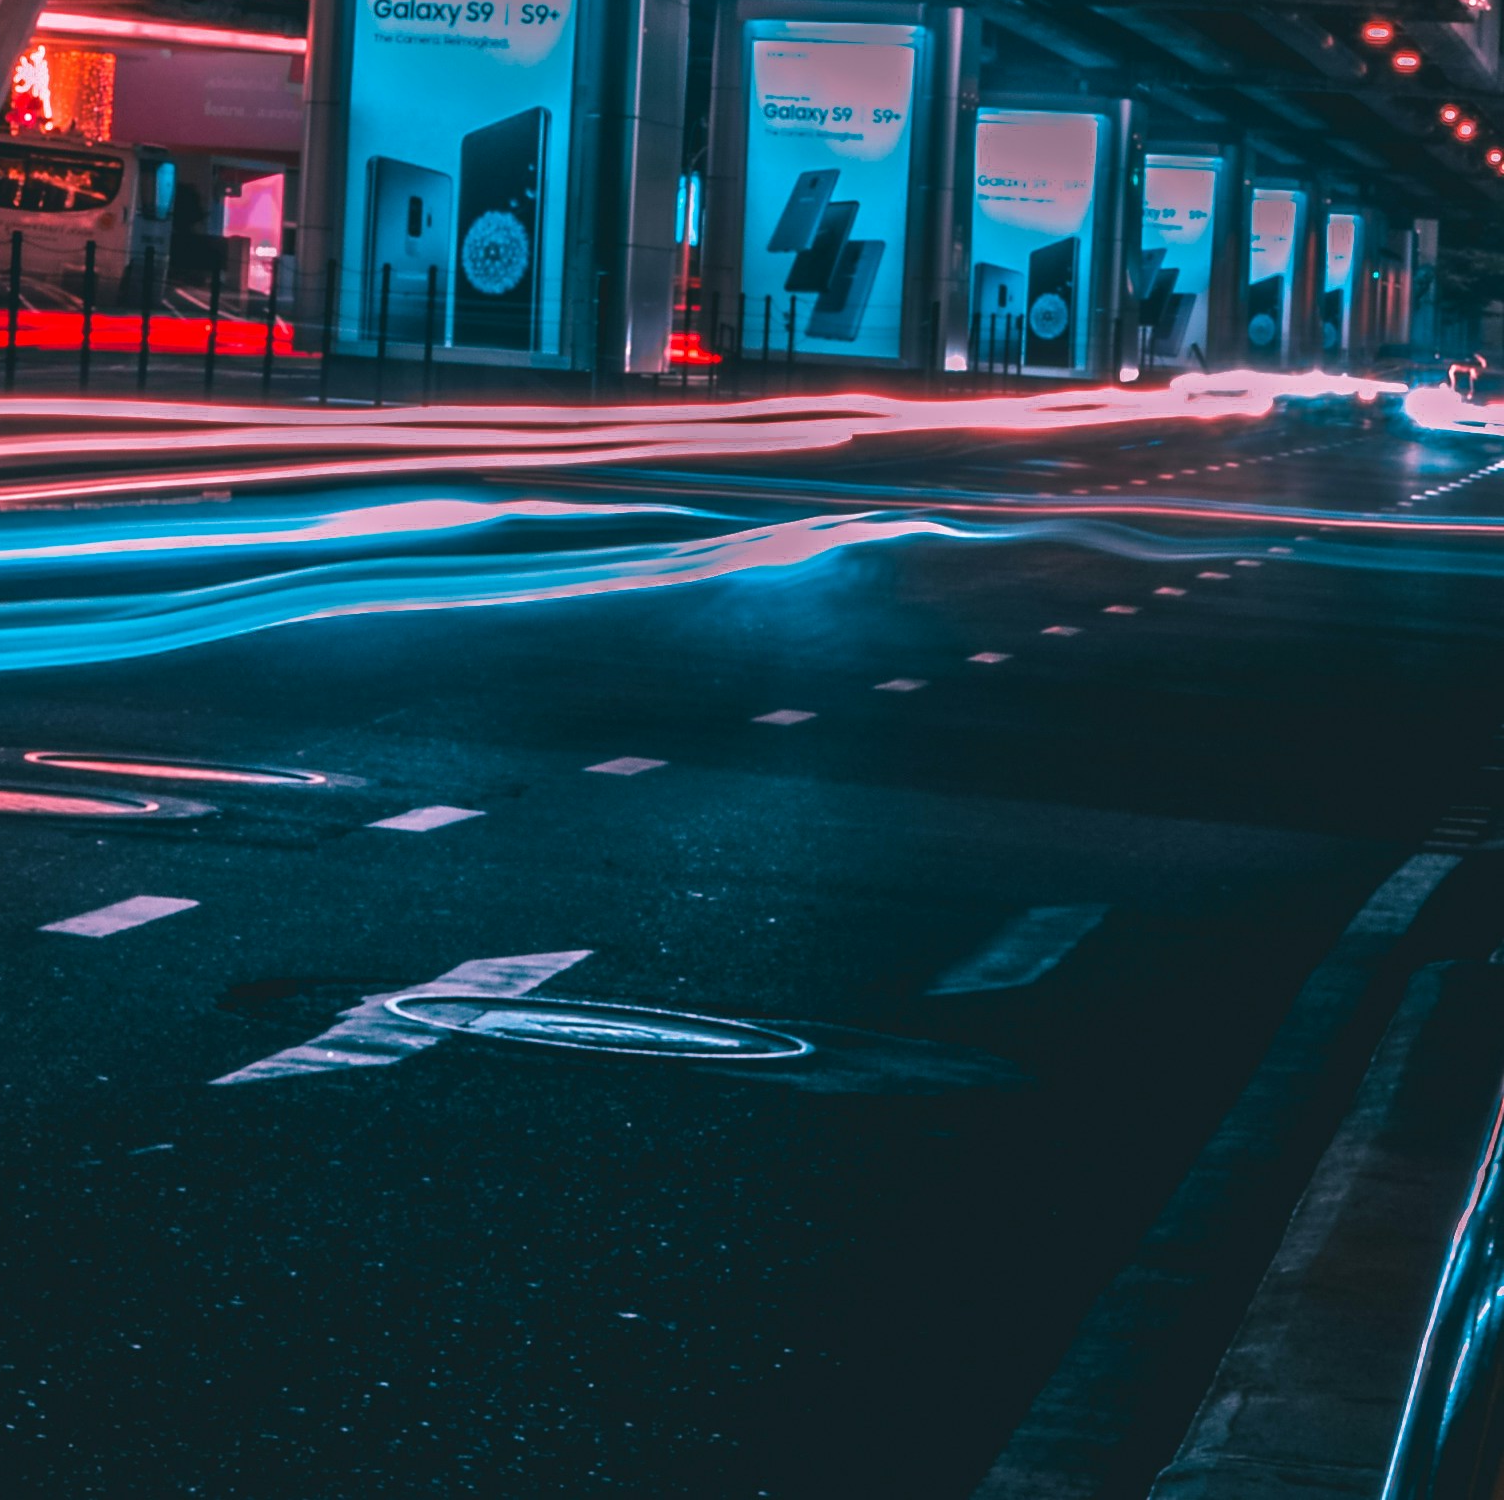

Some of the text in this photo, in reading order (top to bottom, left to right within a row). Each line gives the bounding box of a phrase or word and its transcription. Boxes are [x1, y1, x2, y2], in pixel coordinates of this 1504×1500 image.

[466, 1, 495, 23] S9
[521, 4, 561, 25] S9+
[764, 103, 829, 125] Galaxy
[831, 106, 853, 122] S9
